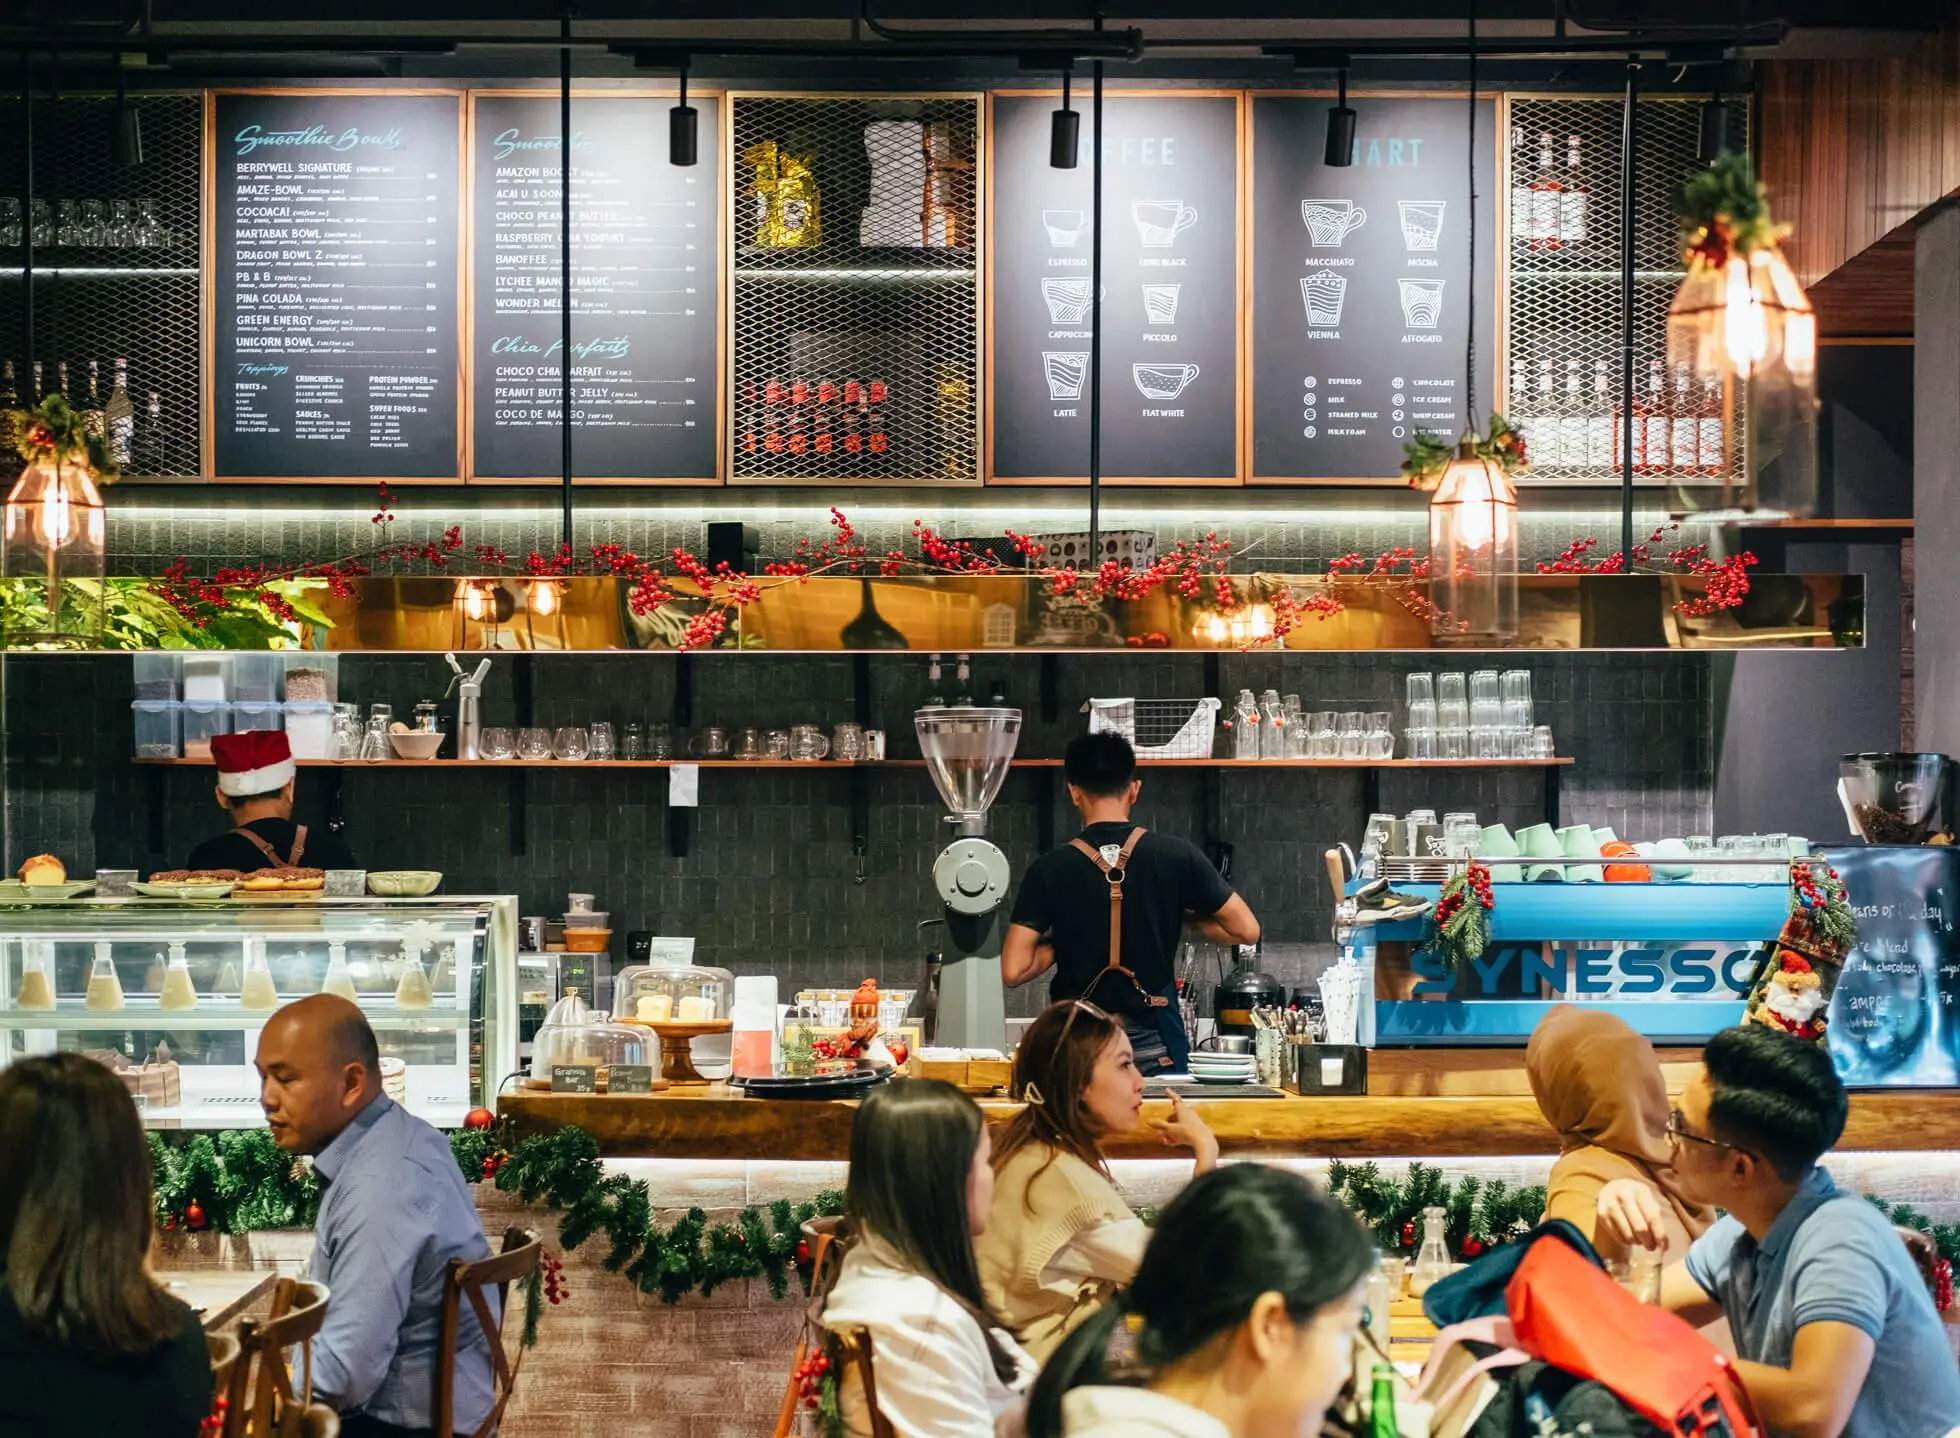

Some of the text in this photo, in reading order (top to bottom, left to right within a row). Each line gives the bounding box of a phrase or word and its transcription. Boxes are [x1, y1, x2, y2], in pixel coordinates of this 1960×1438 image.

[234, 125, 333, 155] Smoothie
[236, 162, 293, 172] BERRYWELL
[298, 162, 352, 172] SIGNATURE
[496, 168, 580, 177] AMAZON BOOT
[236, 184, 304, 194] AMAZE-BOWL
[496, 190, 518, 199] ACAI
[521, 190, 528, 198] U
[236, 207, 290, 216] COCOACAI
[496, 212, 534, 220] CHOCO
[537, 212, 576, 220] PEANT
[236, 228, 288, 238] MARTABAK
[292, 228, 322, 238] BOWL
[496, 234, 552, 243] RASPBERRY
[236, 250, 322, 260] DRAGON BOWL Z
[496, 254, 547, 264] BANOFFEE
[1305, 258, 1354, 266] MACCHIATO
[1408, 258, 1438, 268] MOCHA
[236, 272, 250, 282] PB
[263, 272, 270, 281] B
[496, 276, 532, 286] LYCHEE
[236, 294, 302, 304] PINA COLADA
[496, 298, 578, 308] WONDER MELN
[236, 315, 312, 325] GREEN ENERGY
[1142, 334, 1178, 342] PICCOLO
[1307, 331, 1340, 340] VIENNA
[236, 337, 314, 346] UNICORN BOWL
[491, 336, 542, 354] Chia
[236, 363, 289, 376] Toppings
[496, 367, 534, 376] CHOCO
[537, 367, 560, 376] CHIA
[496, 388, 608, 398] PEANUT BUTTR JELLY
[496, 410, 585, 419] COCO DE MAGO
[1054, 408, 1077, 417] LATTE
[1160, 409, 1184, 417] WHITE
